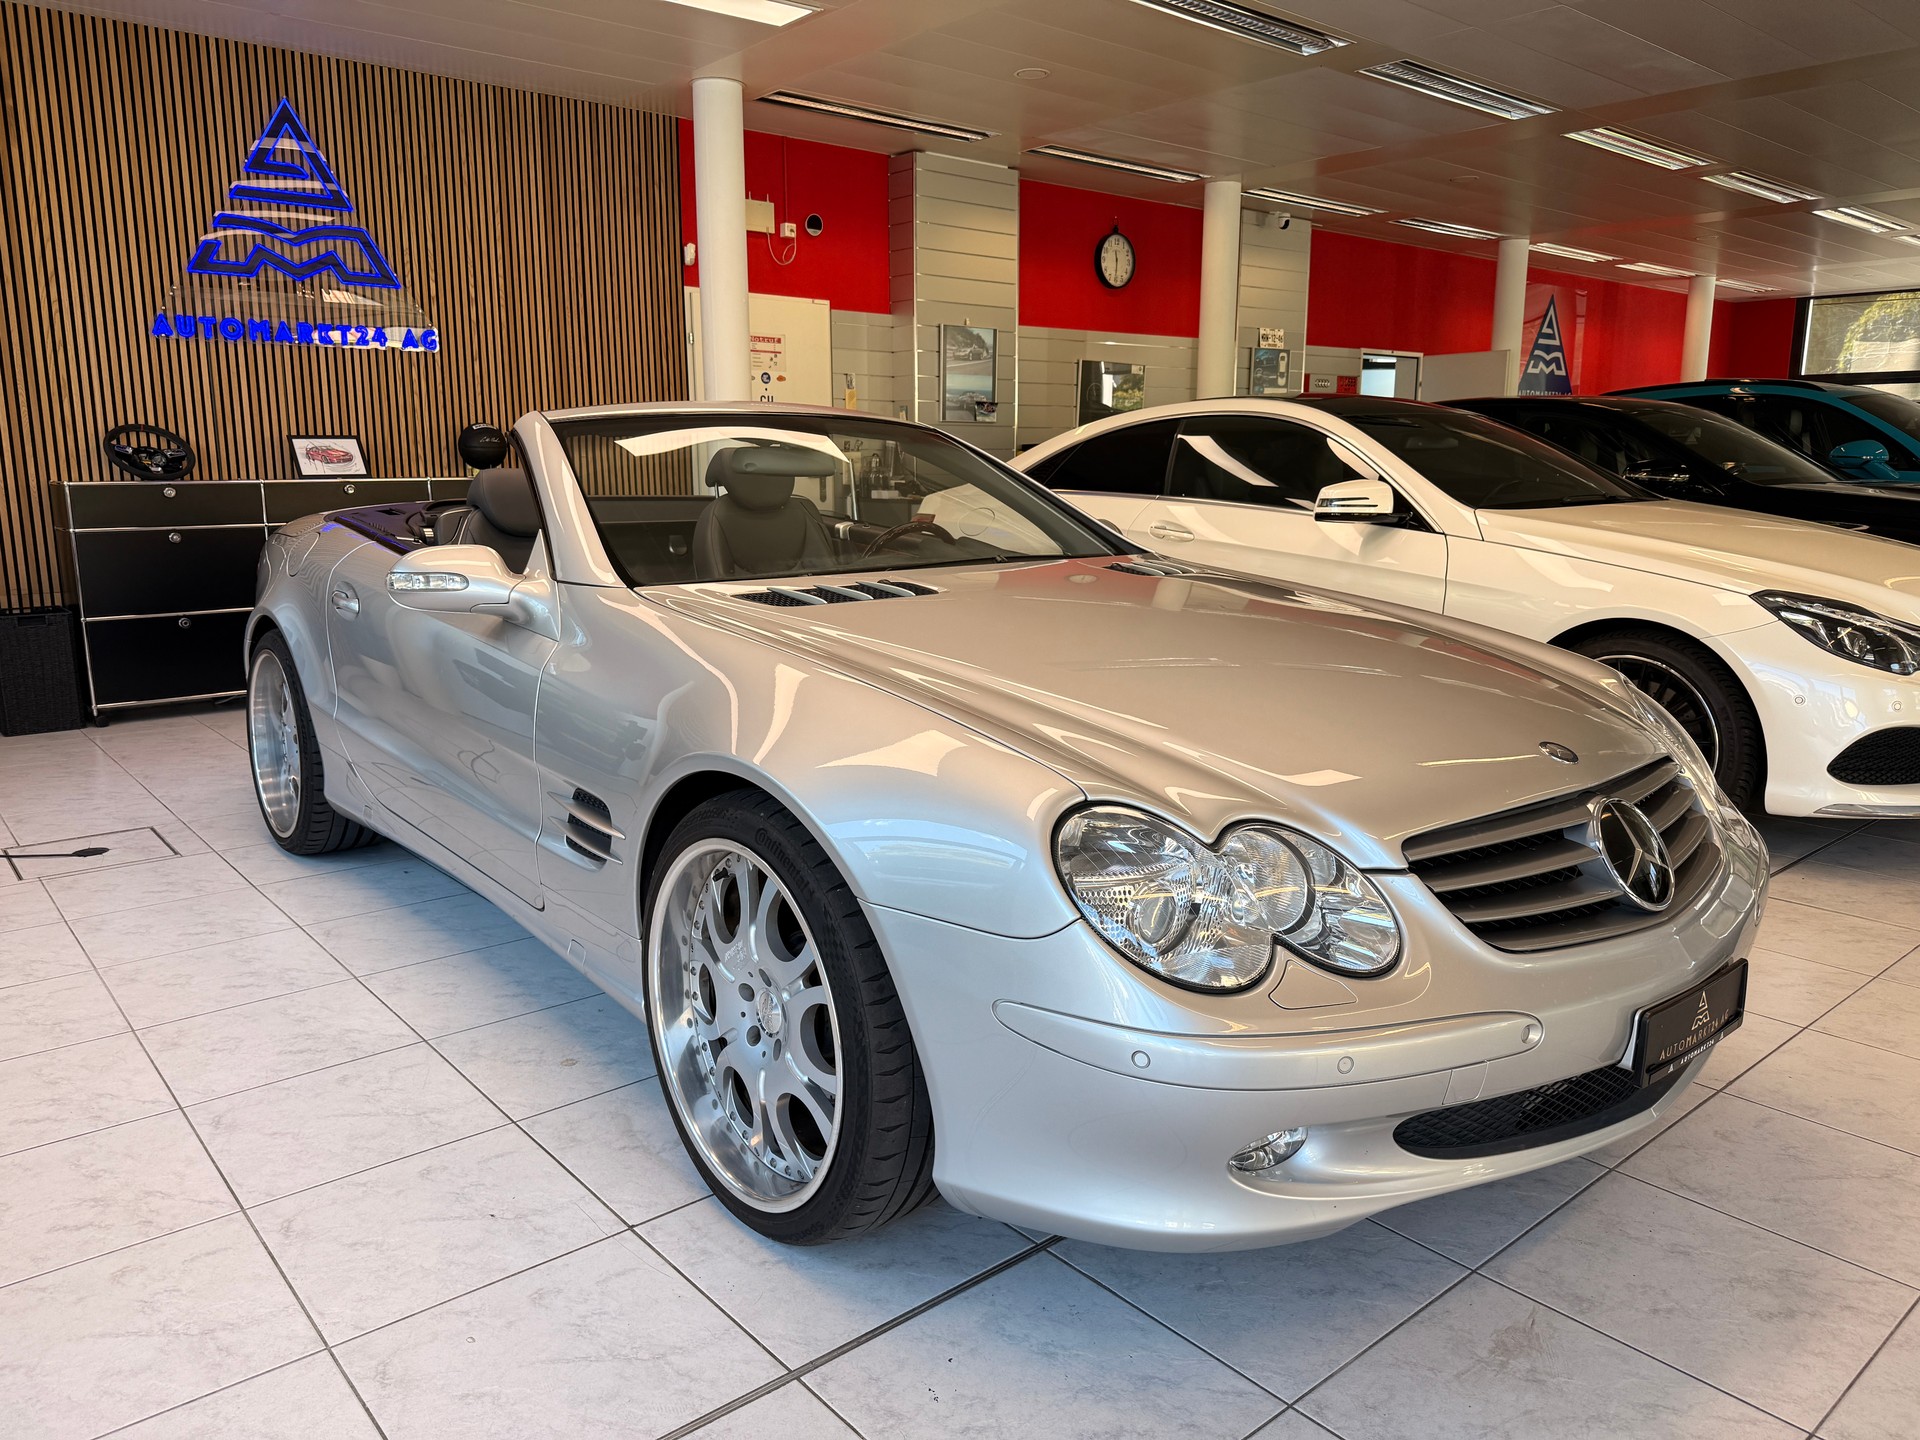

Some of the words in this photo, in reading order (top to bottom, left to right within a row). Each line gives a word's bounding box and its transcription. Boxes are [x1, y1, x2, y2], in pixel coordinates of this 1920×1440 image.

[152, 312, 388, 348] AUTOMARKT24
[402, 328, 438, 351] AG
[755, 827, 811, 892] Continental
[1660, 1018, 1719, 1060] AUTOMARKT24
[1680, 1039, 1715, 1064] AUTOMARKT24
